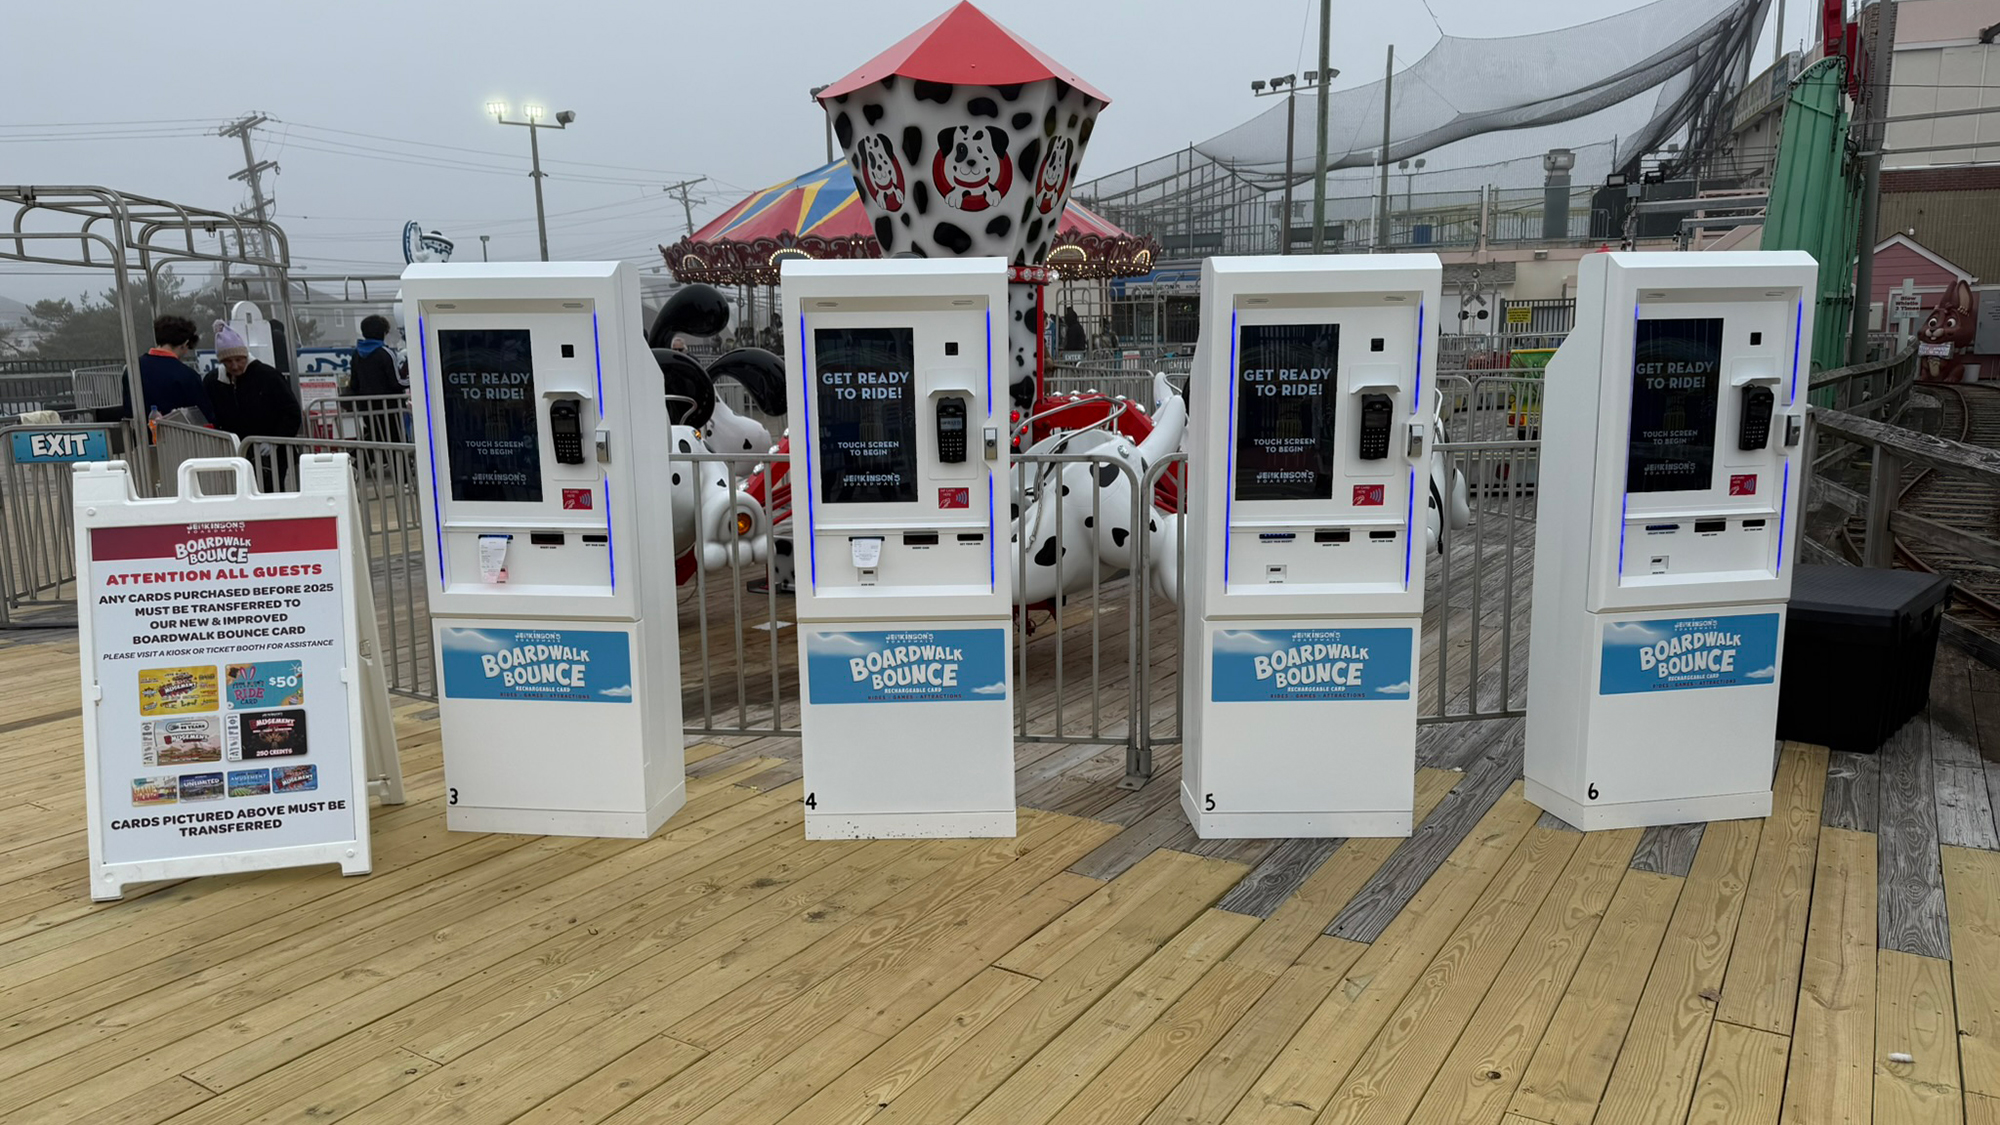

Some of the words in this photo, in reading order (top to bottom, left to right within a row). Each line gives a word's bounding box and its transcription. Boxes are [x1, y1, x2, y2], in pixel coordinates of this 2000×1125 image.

[1244, 369, 1274, 381] GET
[1280, 368, 1331, 380] READY
[1636, 363, 1663, 374] GET
[1668, 362, 1713, 373] READY
[448, 373, 476, 384] GET
[482, 373, 530, 384] READY
[822, 373, 852, 384] GET
[858, 372, 909, 384] READY
[1646, 378, 1665, 389] TO
[1669, 377, 1705, 388] RIDE!
[461, 388, 480, 399] TO
[486, 388, 524, 399] RIDE!
[836, 388, 856, 399] TO
[862, 388, 902, 399] RIDE!
[1256, 385, 1276, 396] TO
[1282, 384, 1322, 396] RIDE!
[30, 432, 90, 457] EXIT
[186, 522, 245, 531] JENKINSONS
[175, 536, 251, 560] BOARDWALK
[188, 548, 248, 565] BOUNCE
[106, 570, 211, 586] ATTENTION
[216, 568, 248, 580] ALL
[253, 564, 322, 577] GUESTS
[99, 595, 126, 604] ANY
[128, 592, 172, 603] CARDS
[174, 588, 250, 600] PURCHASED
[252, 585, 302, 596] BEFORE
[303, 583, 334, 593] 2025
[135, 606, 170, 616] MUST
[172, 605, 189, 614] BE
[190, 600, 282, 613] TRANSFERRED
[284, 599, 301, 608] TO
[150, 620, 177, 629] OUR
[180, 618, 210, 628] NEW
[211, 617, 221, 626] &
[223, 614, 288, 626] IMPROVED
[133, 632, 214, 644] BOARDWALK
[217, 628, 269, 640] BOUNCE
[272, 626, 306, 636] CARD
[205, 646, 235, 654] TICKET
[236, 643, 265, 652] BOOTH
[266, 642, 283, 650] FOR
[284, 640, 334, 649] ASSISTANCE
[1640, 631, 1741, 671] BOARDWALK
[481, 644, 590, 678] BOARDWALK
[850, 645, 963, 682] BOARDWALK
[1254, 644, 1369, 680] BOARDWALK
[1658, 649, 1736, 678] BOUNCE
[269, 676, 297, 688] $50
[503, 662, 586, 687] BOUNCE
[872, 663, 958, 690] BOUNCE
[1276, 662, 1363, 688] BOUNCE
[235, 688, 265, 700] RIDE
[184, 778, 220, 787] UNLIMITED
[449, 788, 459, 805] 3
[1587, 783, 1599, 800] 6
[805, 793, 817, 810] 4
[1205, 793, 1216, 811] 5
[111, 817, 160, 830] CARDS
[163, 811, 234, 825] PICTURED
[237, 806, 285, 819] ABOVE
[288, 802, 326, 814] MUST
[328, 800, 346, 810] BE
[179, 819, 282, 837] TRANSFERRED
